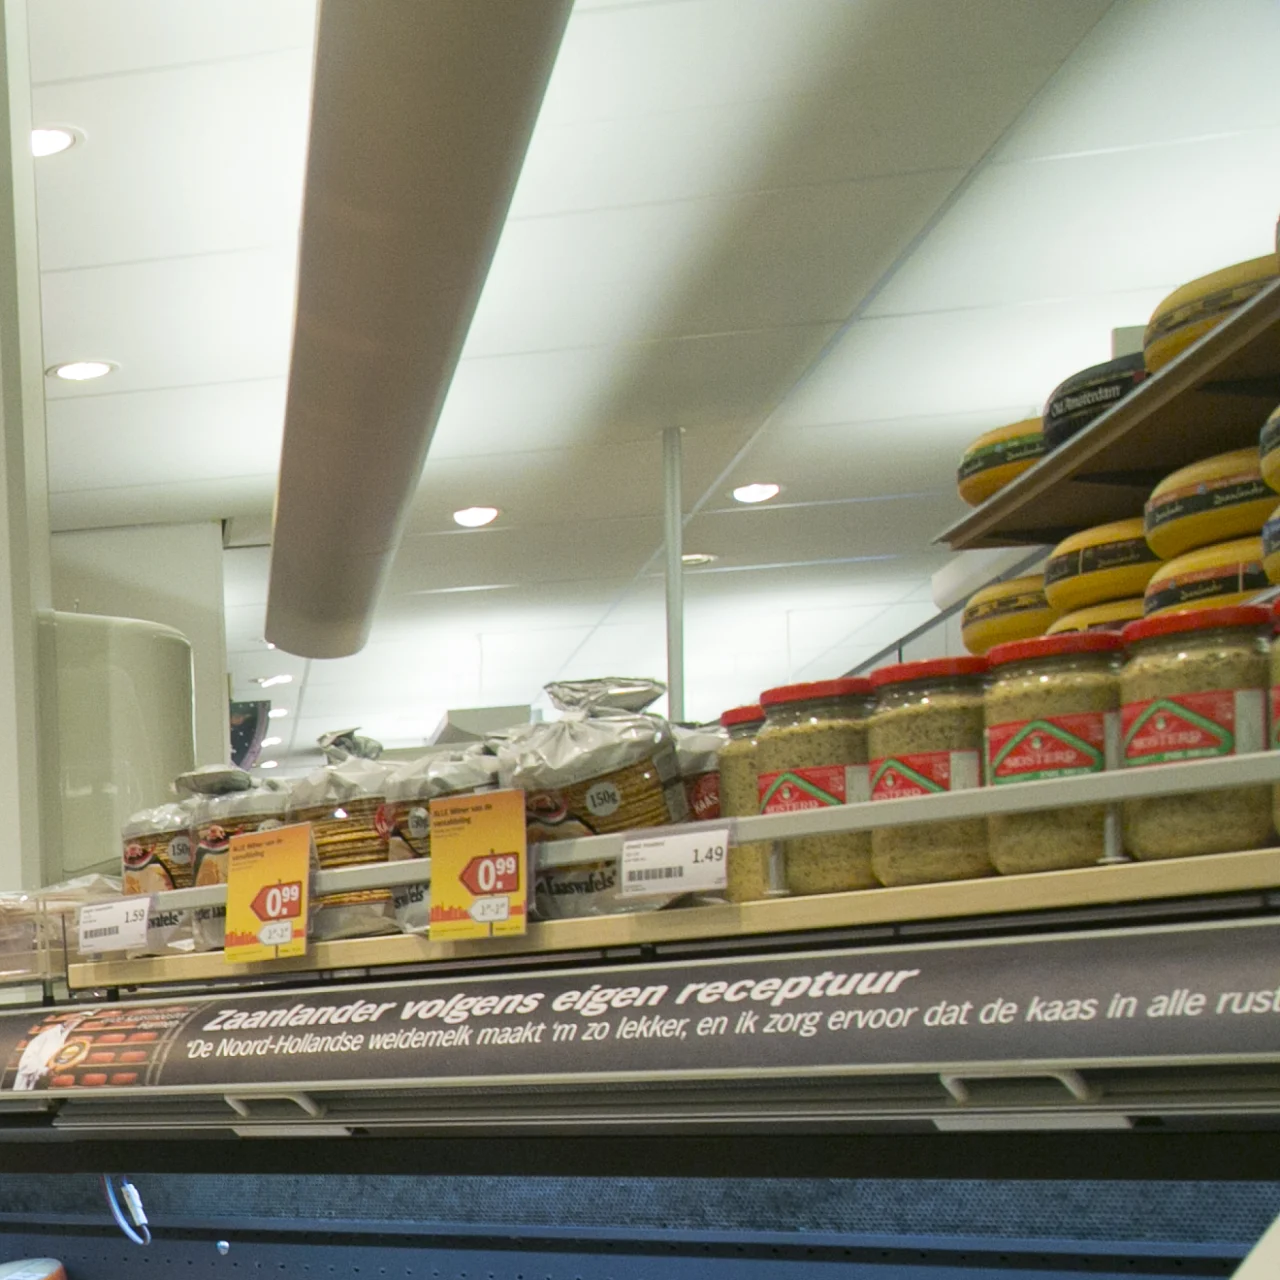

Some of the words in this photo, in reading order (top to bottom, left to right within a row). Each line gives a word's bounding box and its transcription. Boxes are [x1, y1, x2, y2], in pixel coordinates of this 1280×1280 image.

[1131, 731, 1202, 749] MOSTERD
[1004, 751, 1077, 768] MOSTERD
[590, 789, 618, 808] 150g
[693, 792, 719, 814] KAAS
[692, 846, 724, 864] 1.49
[478, 857, 516, 891] 0.99
[266, 885, 300, 917] 0.99
[124, 909, 145, 924] 1.59
[203, 1001, 395, 1031] Zaanlander
[400, 993, 544, 1024] volgens
[552, 984, 668, 1016] eigen
[675, 969, 921, 1006] receptuur
[216, 1030, 365, 1057] Noord-Hollandse
[368, 1025, 472, 1050] weidemelk
[476, 1021, 546, 1046] maakt
[581, 1022, 609, 1041] zo
[616, 1015, 690, 1041] lekker,
[696, 1014, 728, 1036] en
[734, 1011, 760, 1034] ik
[763, 1011, 823, 1037] zorg
[827, 1006, 918, 1031] ervoor
[923, 1000, 973, 1027] dat
[978, 998, 1018, 1025] de
[1026, 996, 1098, 1022] kaas
[1106, 993, 1138, 1019] in
[1146, 989, 1207, 1018] alle
